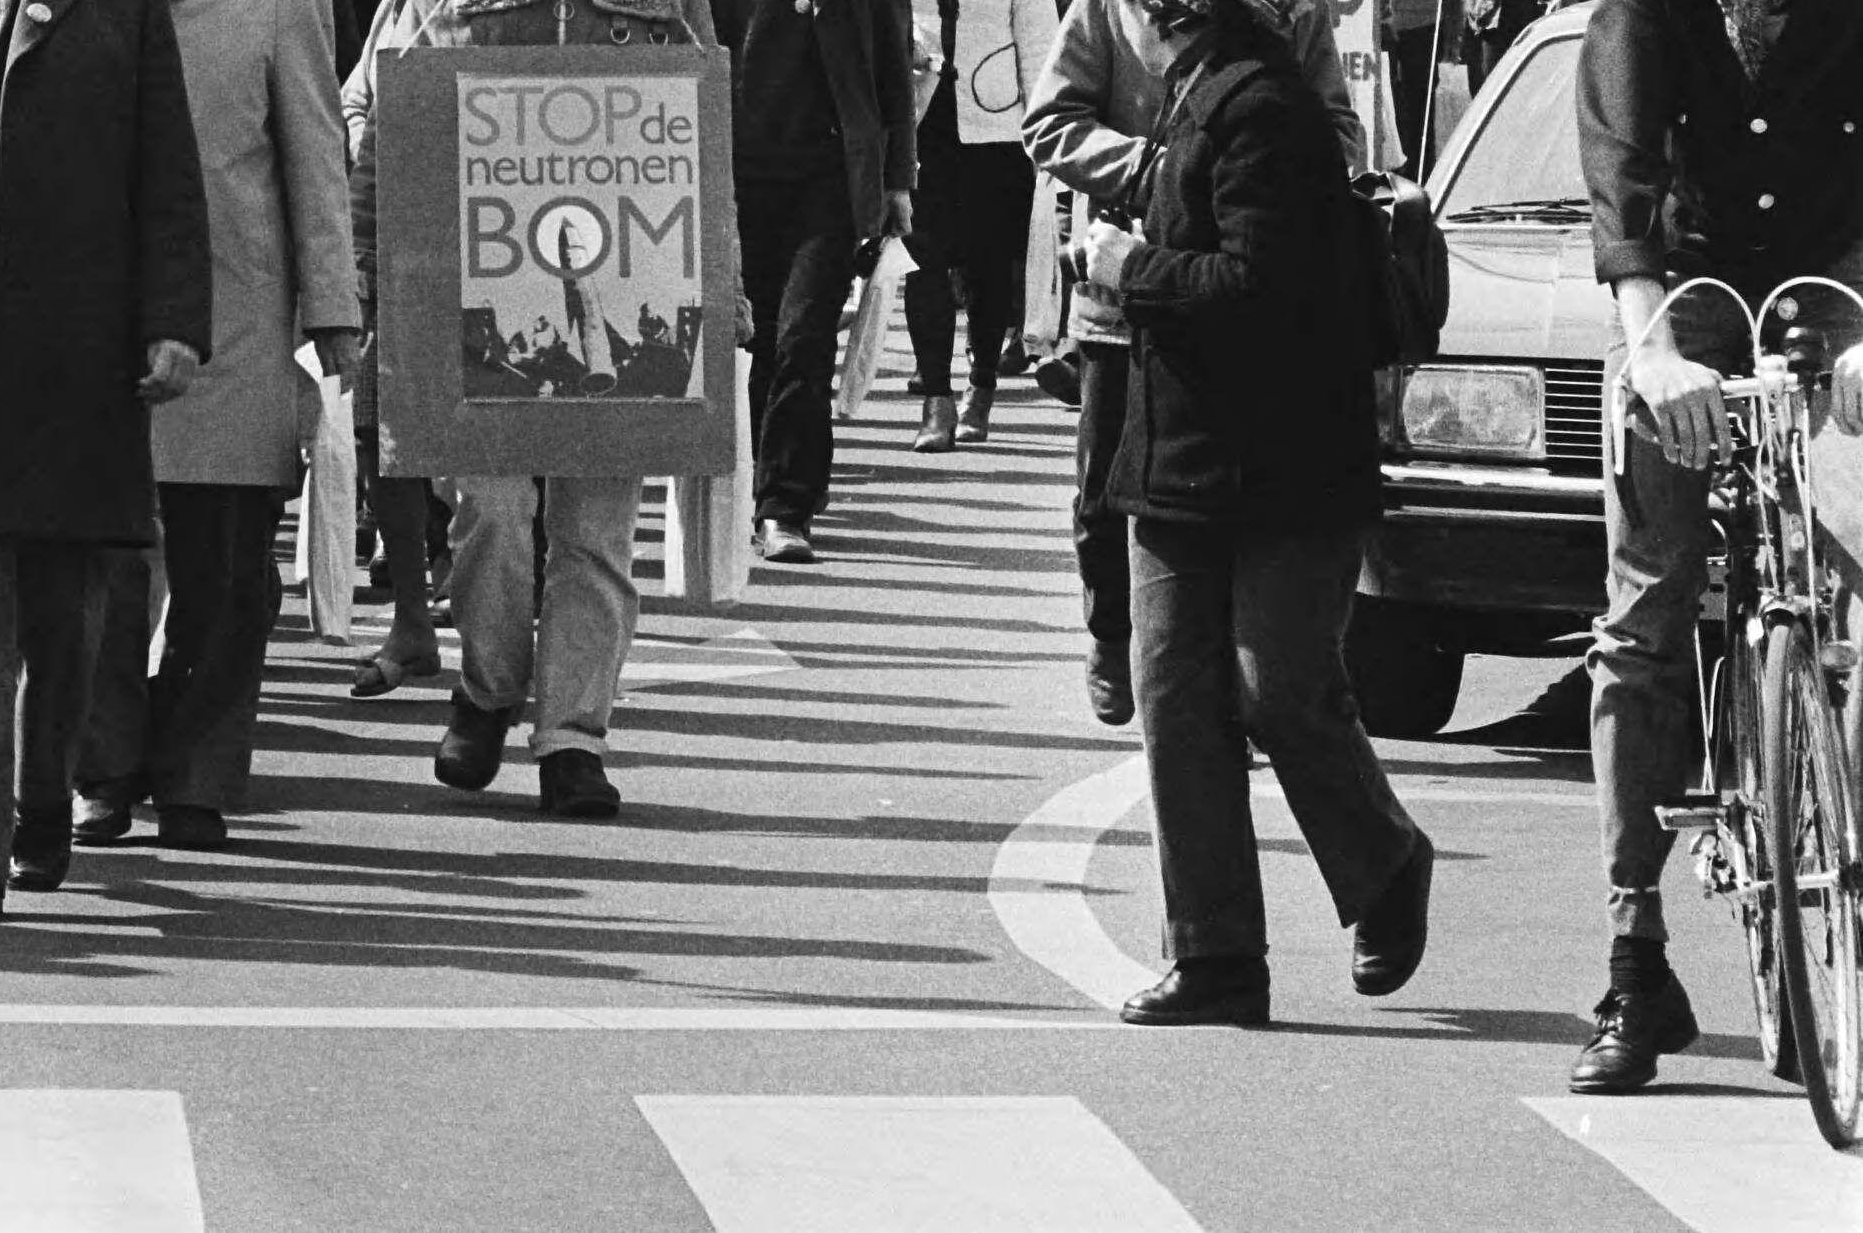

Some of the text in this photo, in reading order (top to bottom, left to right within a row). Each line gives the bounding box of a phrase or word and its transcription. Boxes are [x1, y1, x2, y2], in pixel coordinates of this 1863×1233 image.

[464, 85, 693, 146] STOP de
[466, 151, 693, 186] neutronen
[467, 195, 695, 280] BOM
